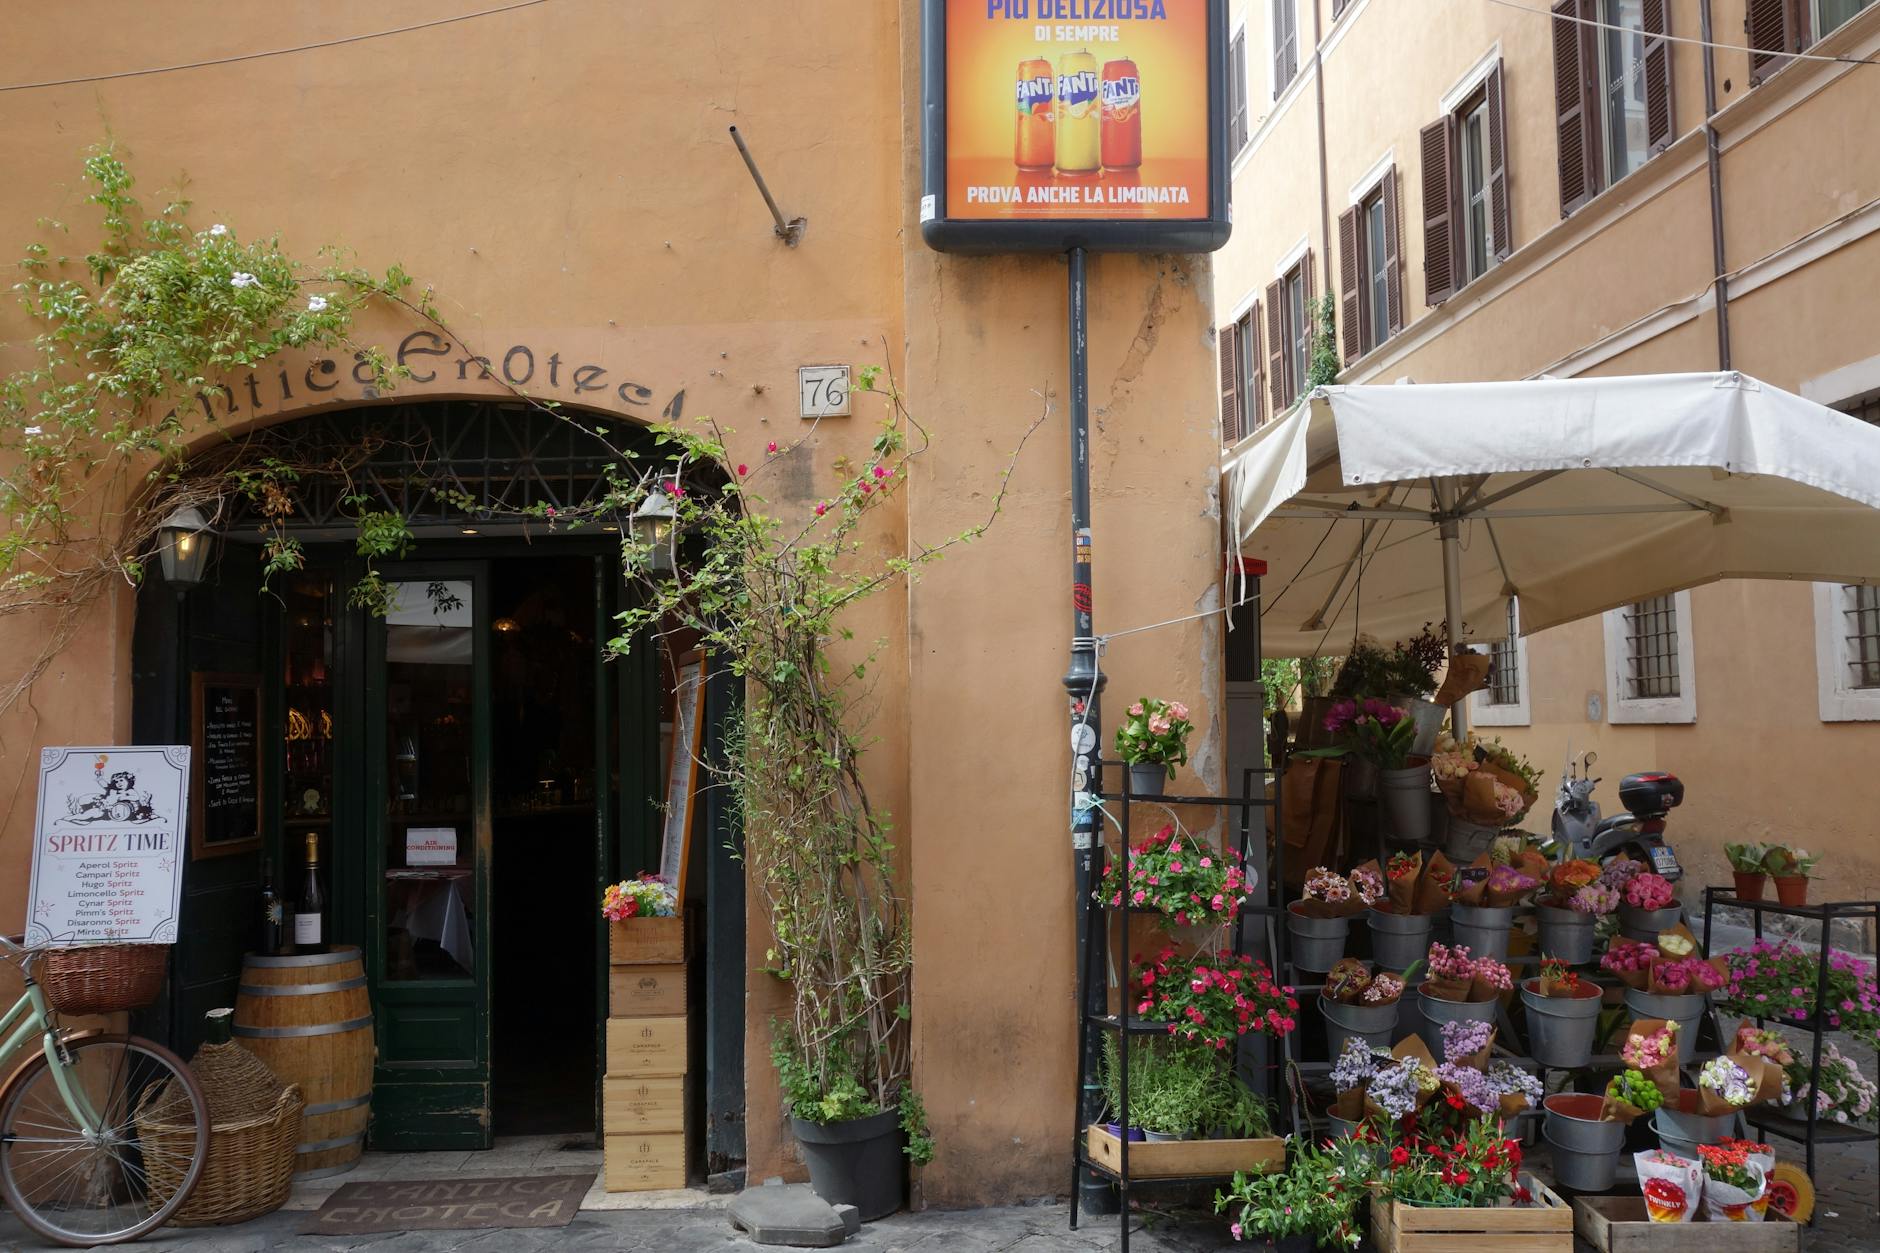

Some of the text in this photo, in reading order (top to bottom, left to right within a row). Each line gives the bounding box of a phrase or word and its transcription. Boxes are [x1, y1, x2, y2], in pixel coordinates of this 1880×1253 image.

[1037, 0, 1167, 20] DELIZIOSA
[1034, 25, 1120, 42] DI SEMPRE
[967, 186, 1190, 203] PROVA ANCHE LA LIMONATA
[805, 376, 844, 407] 76
[48, 832, 170, 853] SPRITZ TIME
[79, 861, 139, 871] Aperol Spritz
[75, 870, 140, 879] Campari Spritz
[81, 880, 133, 889] Hugo Spritz
[67, 889, 145, 898] Limoncello Spritz
[78, 899, 133, 908] Cynar Spritz
[75, 908, 134, 917] Pimm's Spritz
[115, 918, 141, 926] Spritz
[1648, 1194, 1681, 1208] TWINKLY
